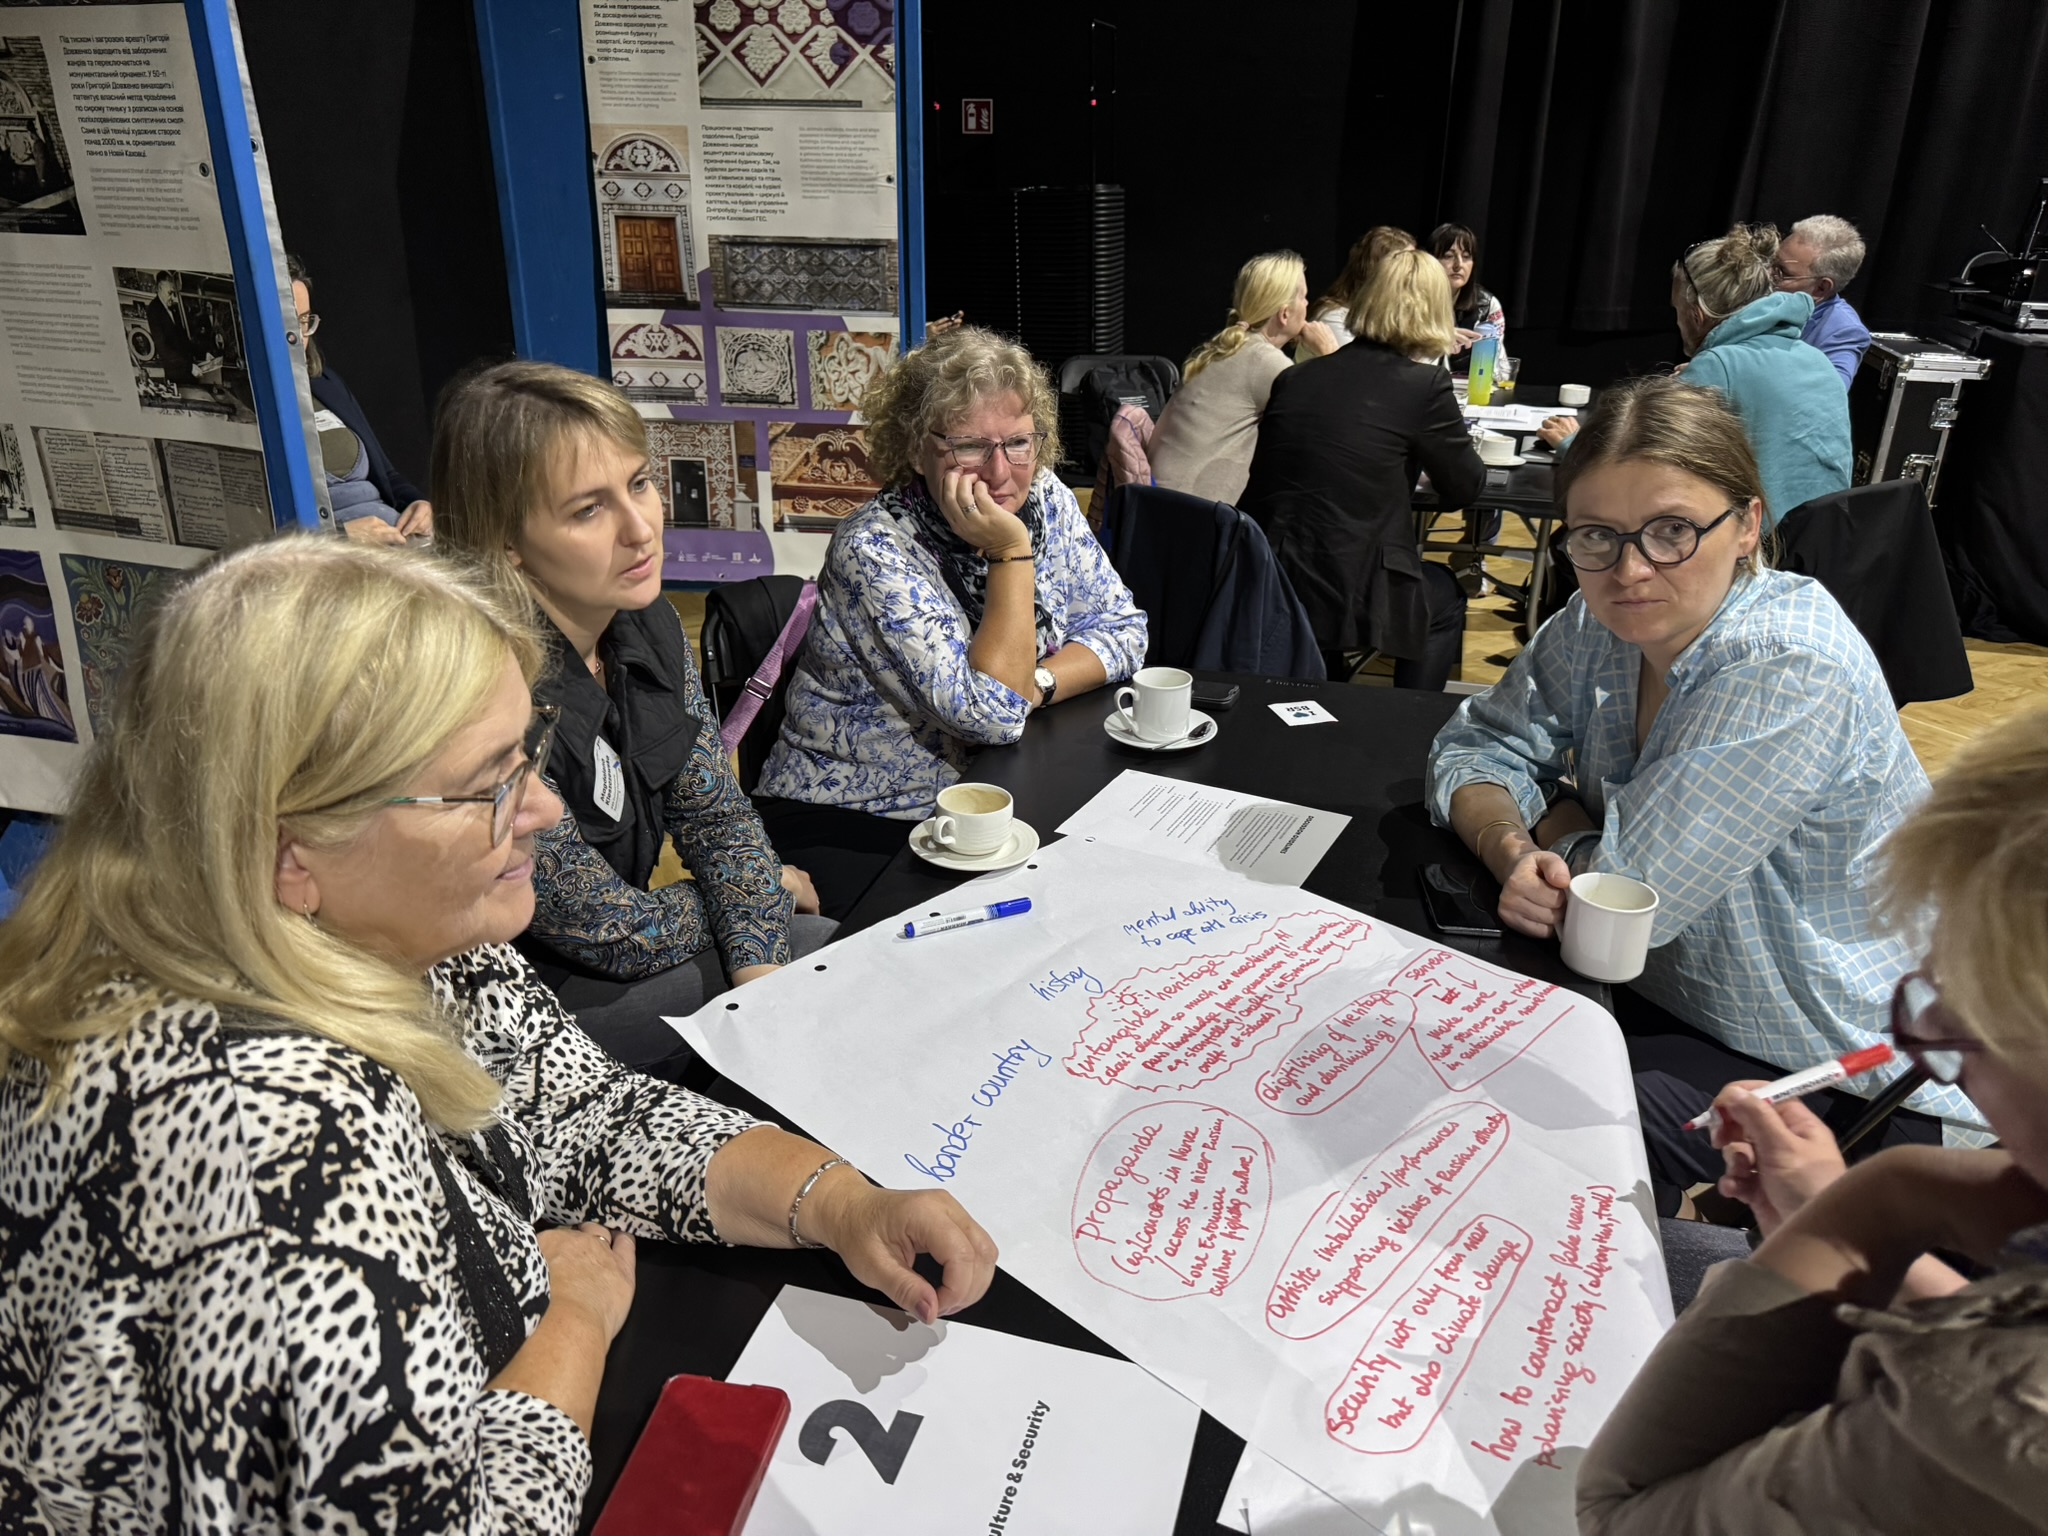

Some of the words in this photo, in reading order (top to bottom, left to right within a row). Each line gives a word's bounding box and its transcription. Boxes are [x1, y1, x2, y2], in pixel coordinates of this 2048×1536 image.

[1141, 935, 1162, 948] to
[904, 1113, 983, 1182] border
[1385, 1317, 1417, 1350] not
[1377, 1396, 1415, 1430] but
[1410, 1360, 1442, 1397] also
[798, 1398, 925, 1486] 2
[1011, 1399, 1051, 1471] Security
[1470, 1417, 1523, 1462] how
[1006, 1469, 1024, 1485] &
[988, 1484, 1019, 1536] ulture
